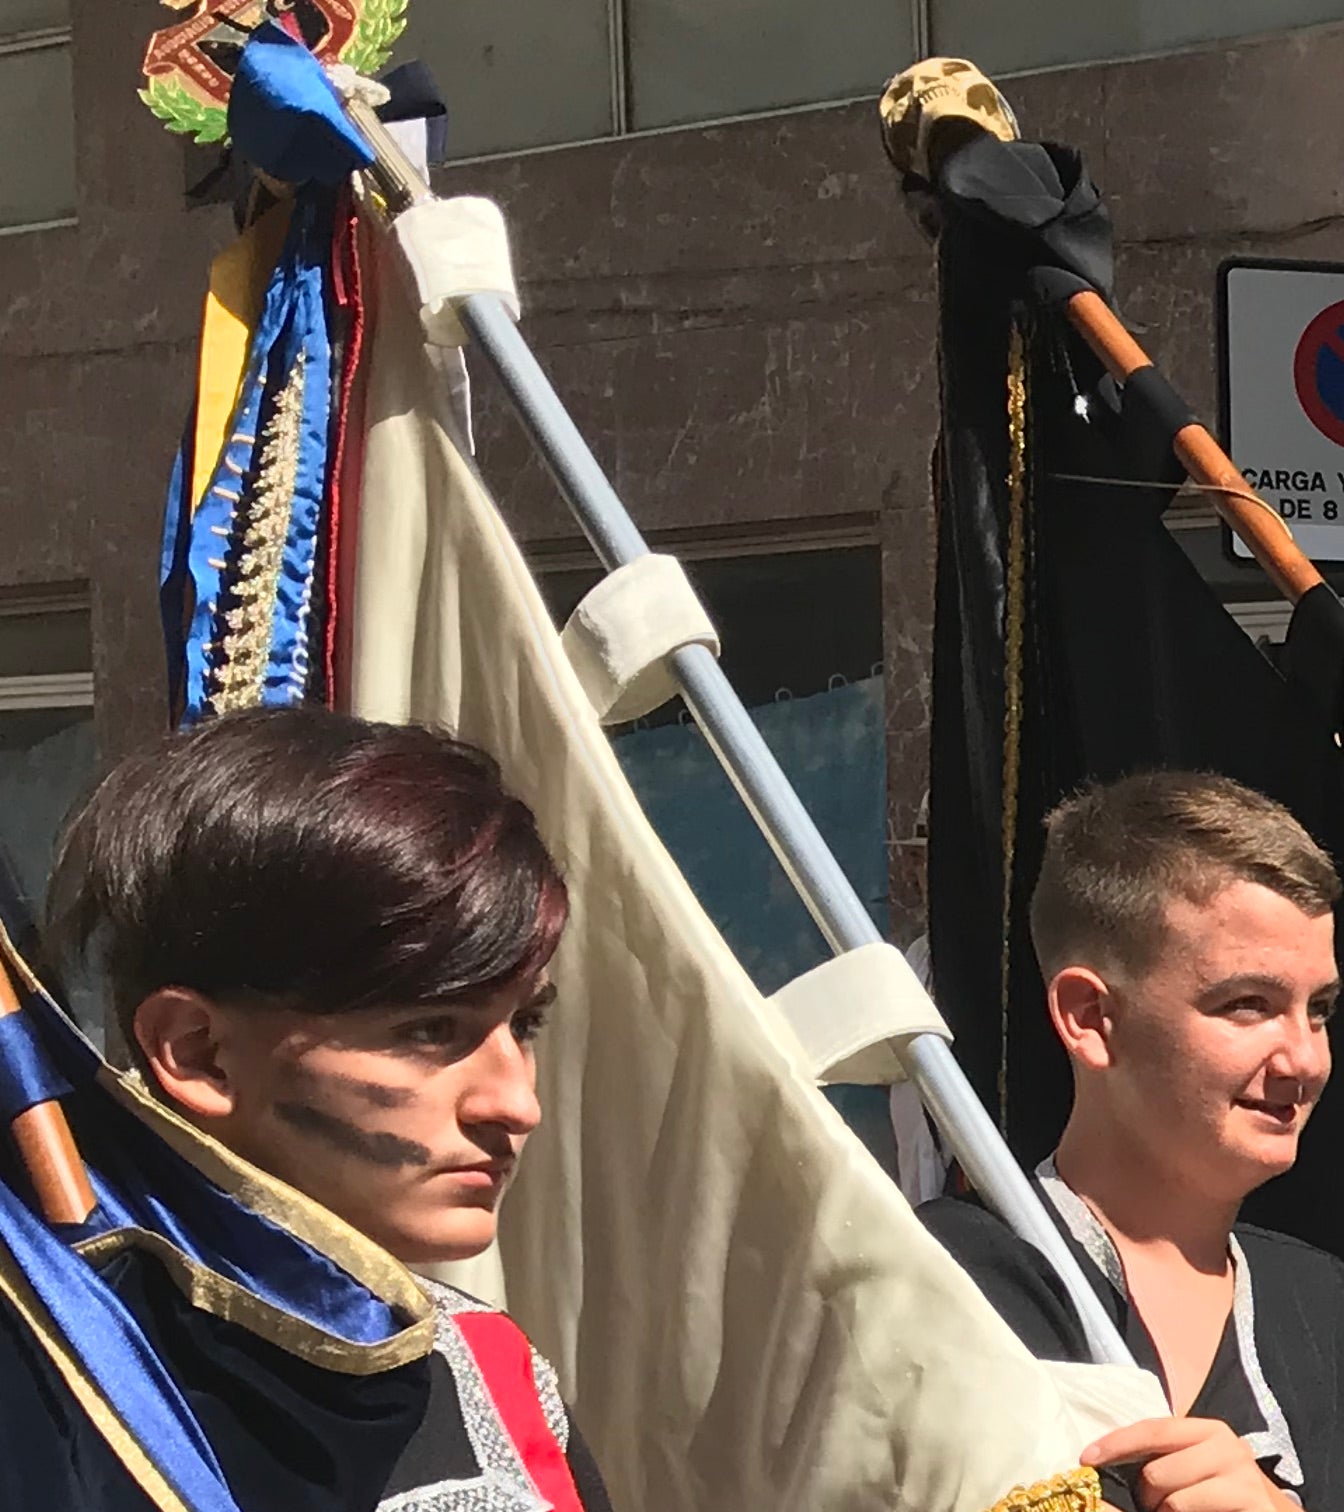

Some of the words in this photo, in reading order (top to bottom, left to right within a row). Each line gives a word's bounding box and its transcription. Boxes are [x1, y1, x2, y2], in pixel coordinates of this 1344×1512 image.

[1241, 467, 1327, 493] CARGA
[1279, 499, 1312, 521] DE
[1322, 500, 1338, 521] 8
